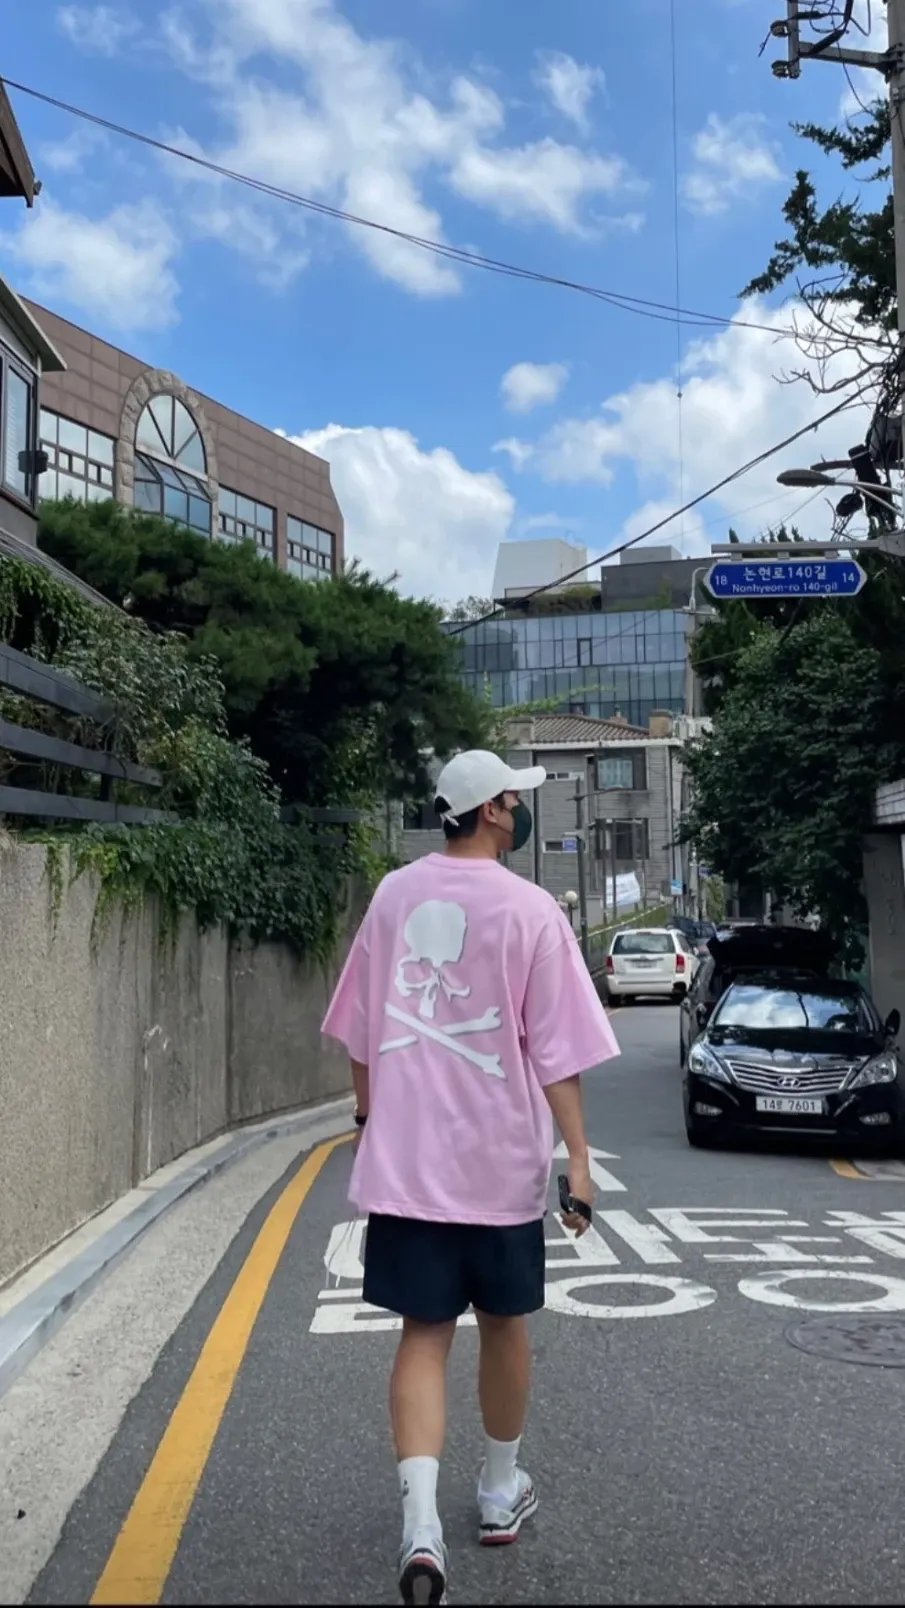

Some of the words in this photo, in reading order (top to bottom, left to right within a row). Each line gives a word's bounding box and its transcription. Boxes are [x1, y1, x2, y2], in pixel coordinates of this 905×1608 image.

[743, 565, 828, 581] 논현로140길
[842, 572, 855, 583] 14
[715, 575, 728, 586] 18
[732, 583, 800, 594] Nonhyeon-ro
[803, 582, 838, 593] 140-gil
[788, 1100, 815, 1111] 7601
